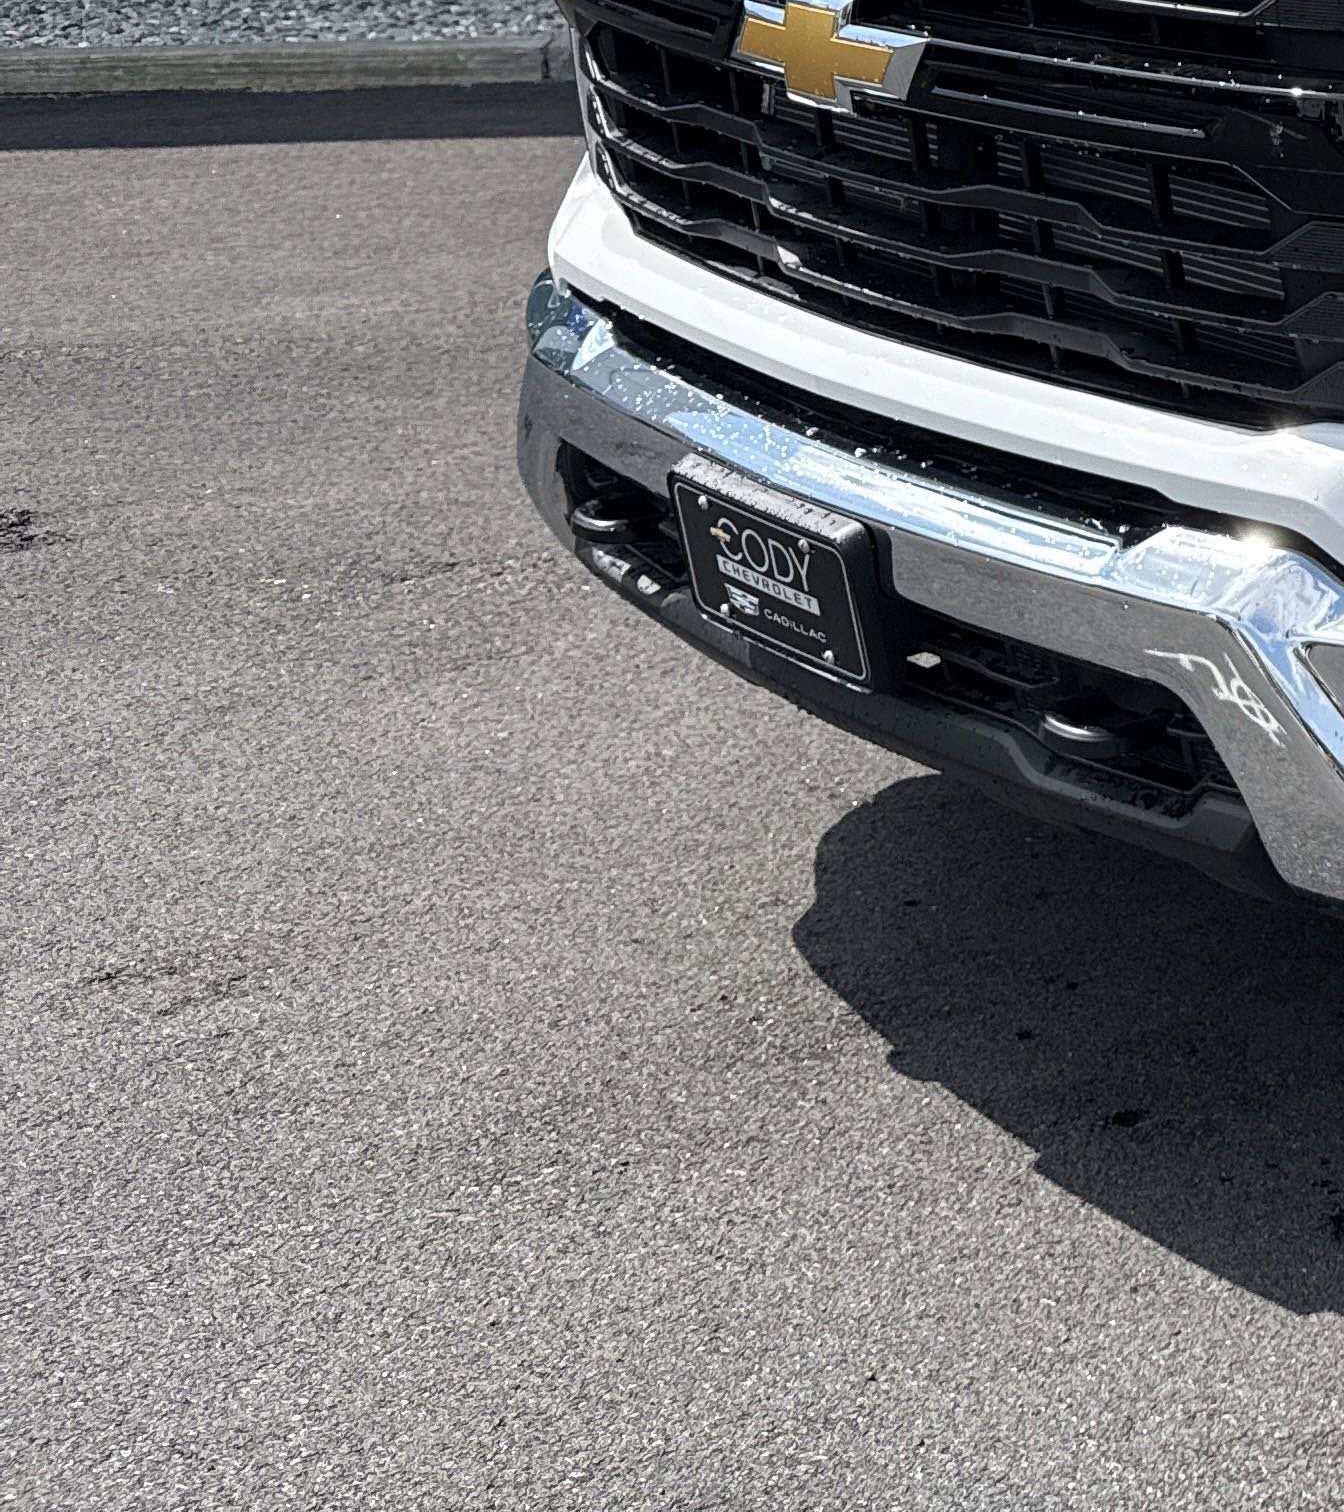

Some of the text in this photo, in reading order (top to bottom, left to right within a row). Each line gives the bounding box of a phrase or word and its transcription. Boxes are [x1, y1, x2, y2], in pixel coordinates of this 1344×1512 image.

[717, 517, 810, 592] CODY
[722, 560, 813, 609] CHEVROLET
[763, 608, 827, 643] CADILLAC
